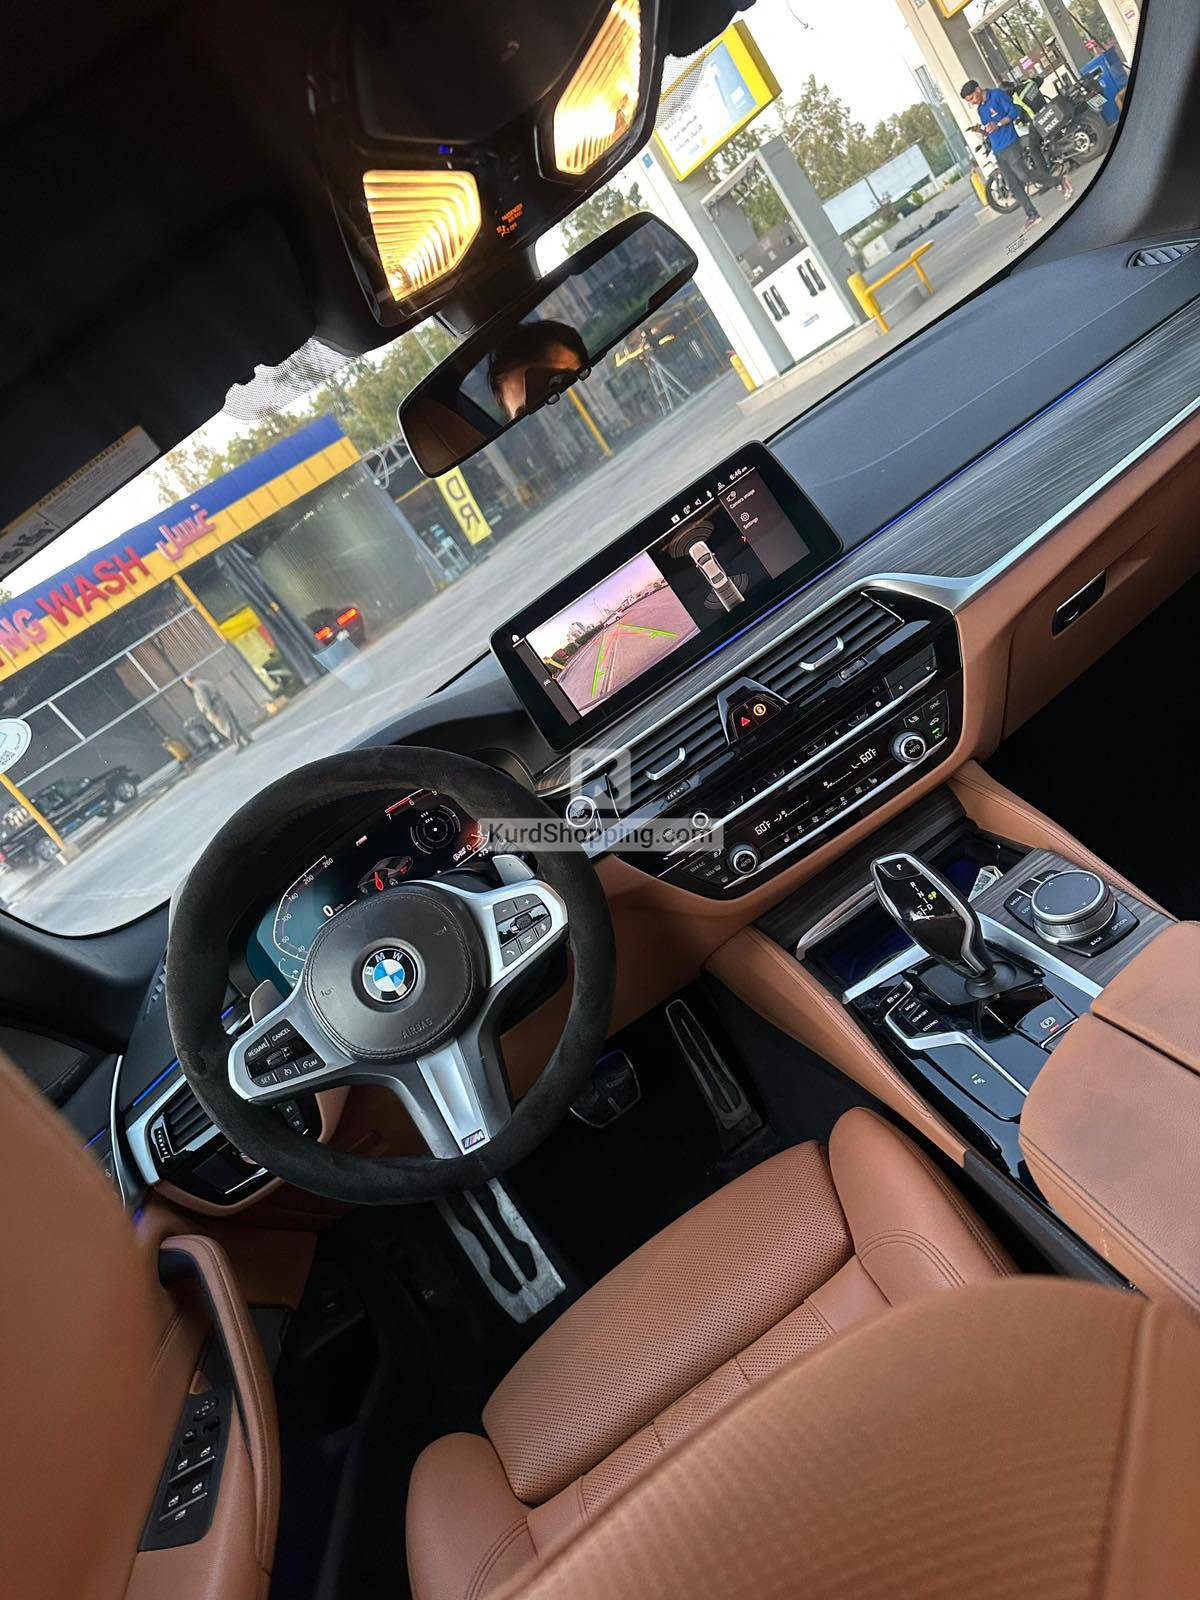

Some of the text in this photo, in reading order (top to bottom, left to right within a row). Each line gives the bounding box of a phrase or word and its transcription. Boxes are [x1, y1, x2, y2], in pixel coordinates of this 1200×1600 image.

[1044, 118, 1061, 133] POLICE
[729, 497, 746, 510] Camera
[742, 517, 759, 530] Settings
[36, 545, 150, 627] WASH
[908, 743, 921, 755] AUTO
[322, 856, 334, 869] 260
[740, 857, 752, 868] AUTO
[302, 873, 315, 886] 200
[287, 891, 299, 903] 140
[322, 903, 334, 918] 0
[1090, 935, 1104, 946] BACK
[364, 950, 404, 977] BMW
[911, 1009, 929, 1024] COMFORT
[271, 1027, 292, 1042] CANCEL
[402, 1017, 434, 1041] AIRBAG
[247, 1042, 268, 1058] RESUME
[260, 1075, 272, 1085] SET
